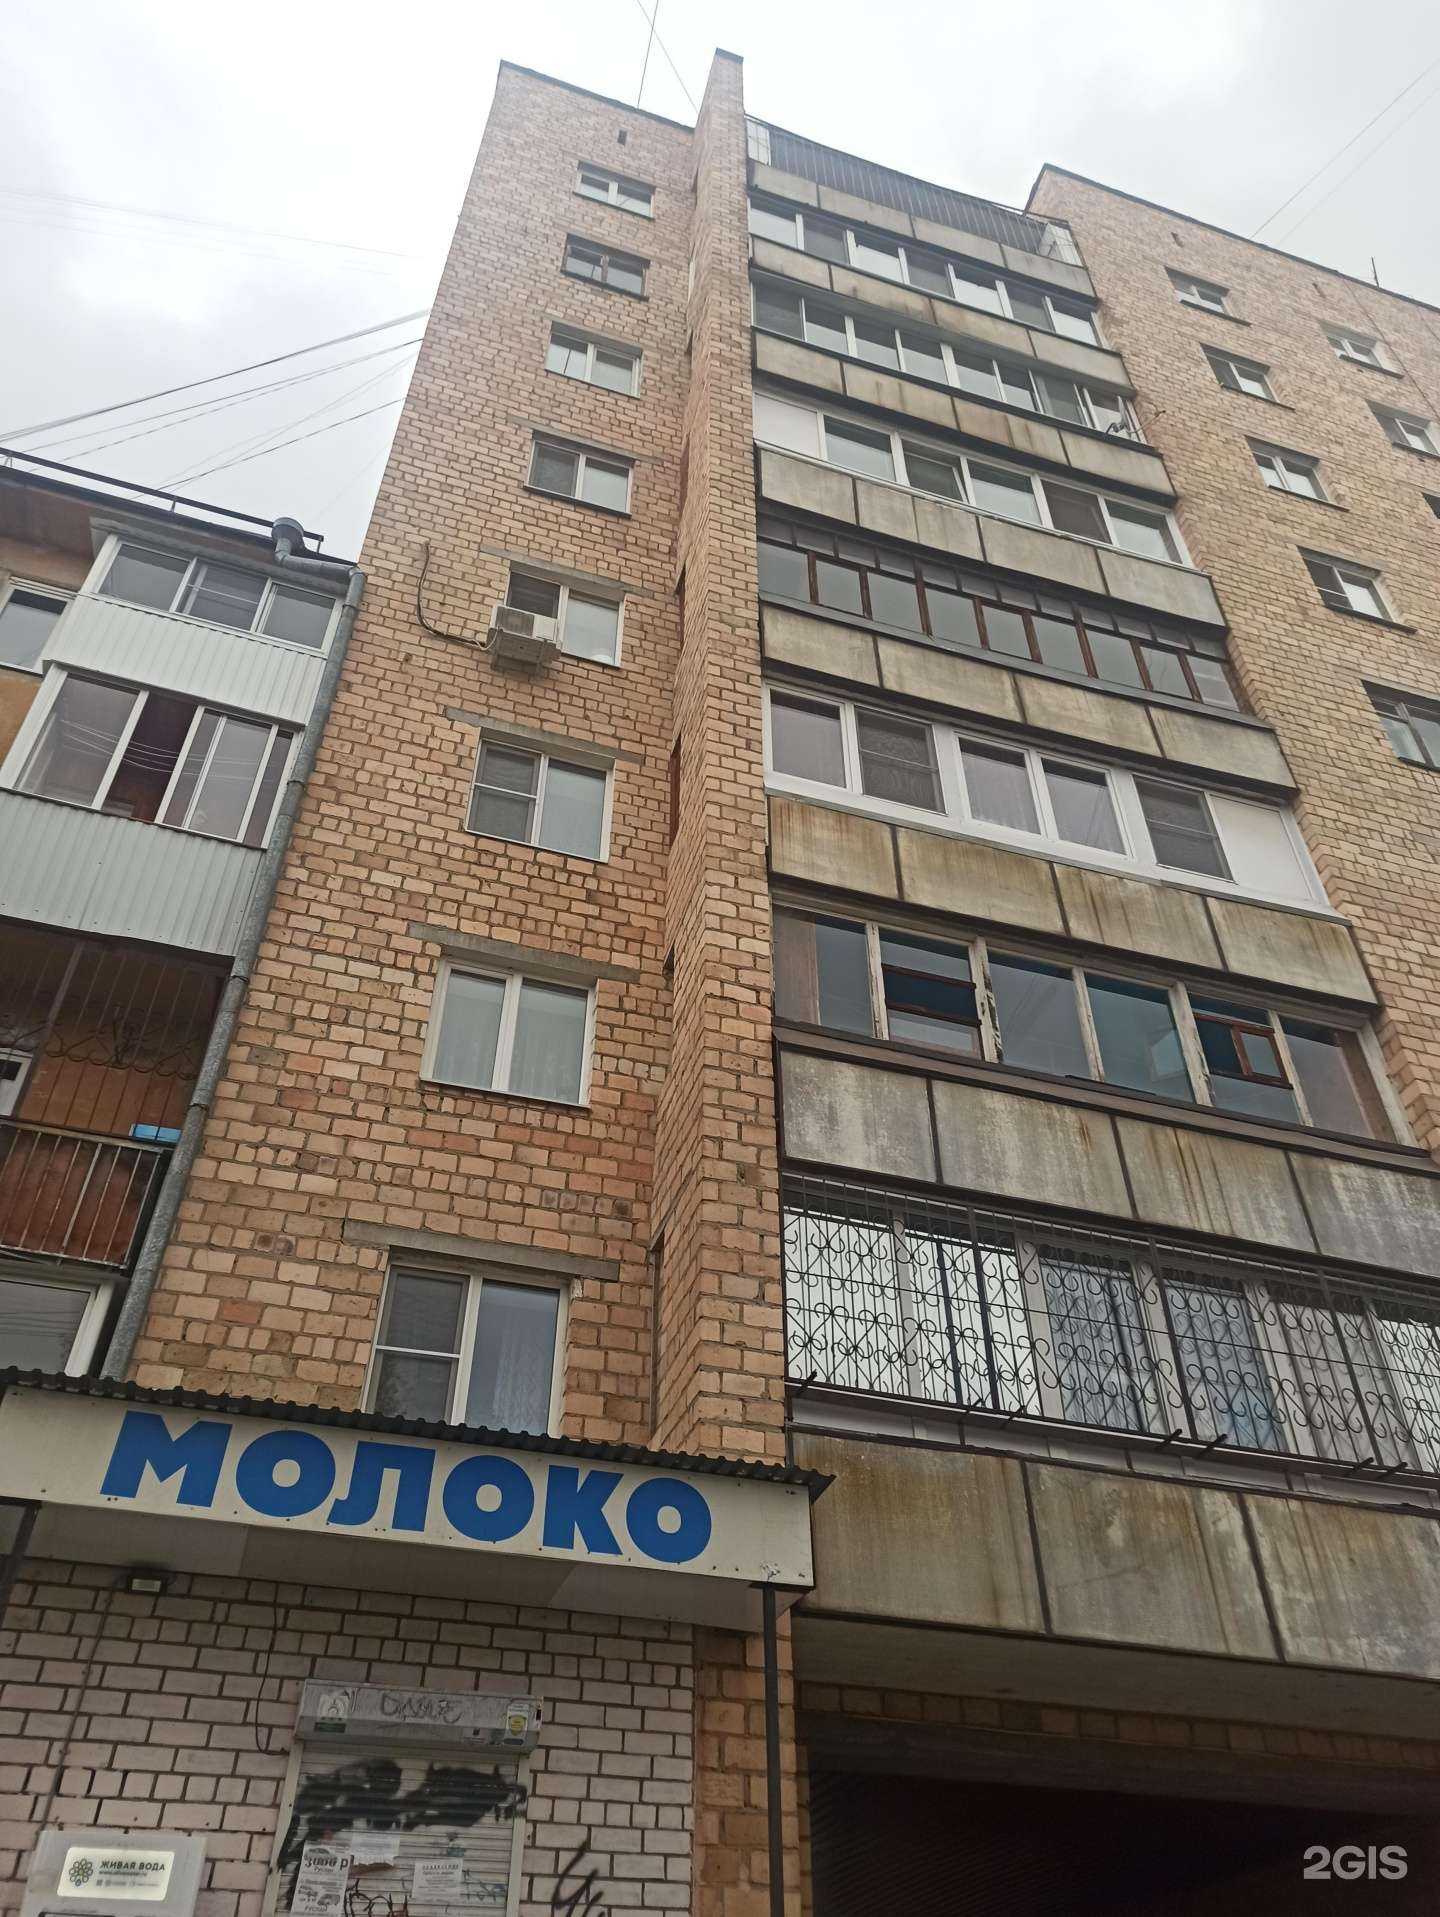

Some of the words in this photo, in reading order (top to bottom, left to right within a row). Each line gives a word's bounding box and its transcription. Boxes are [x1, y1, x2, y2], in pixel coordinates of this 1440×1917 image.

[99, 1410, 712, 1563] МОЛОКО
[100, 1860, 136, 1870] ЖИВАЯ
[138, 1862, 165, 1871] ВОДА
